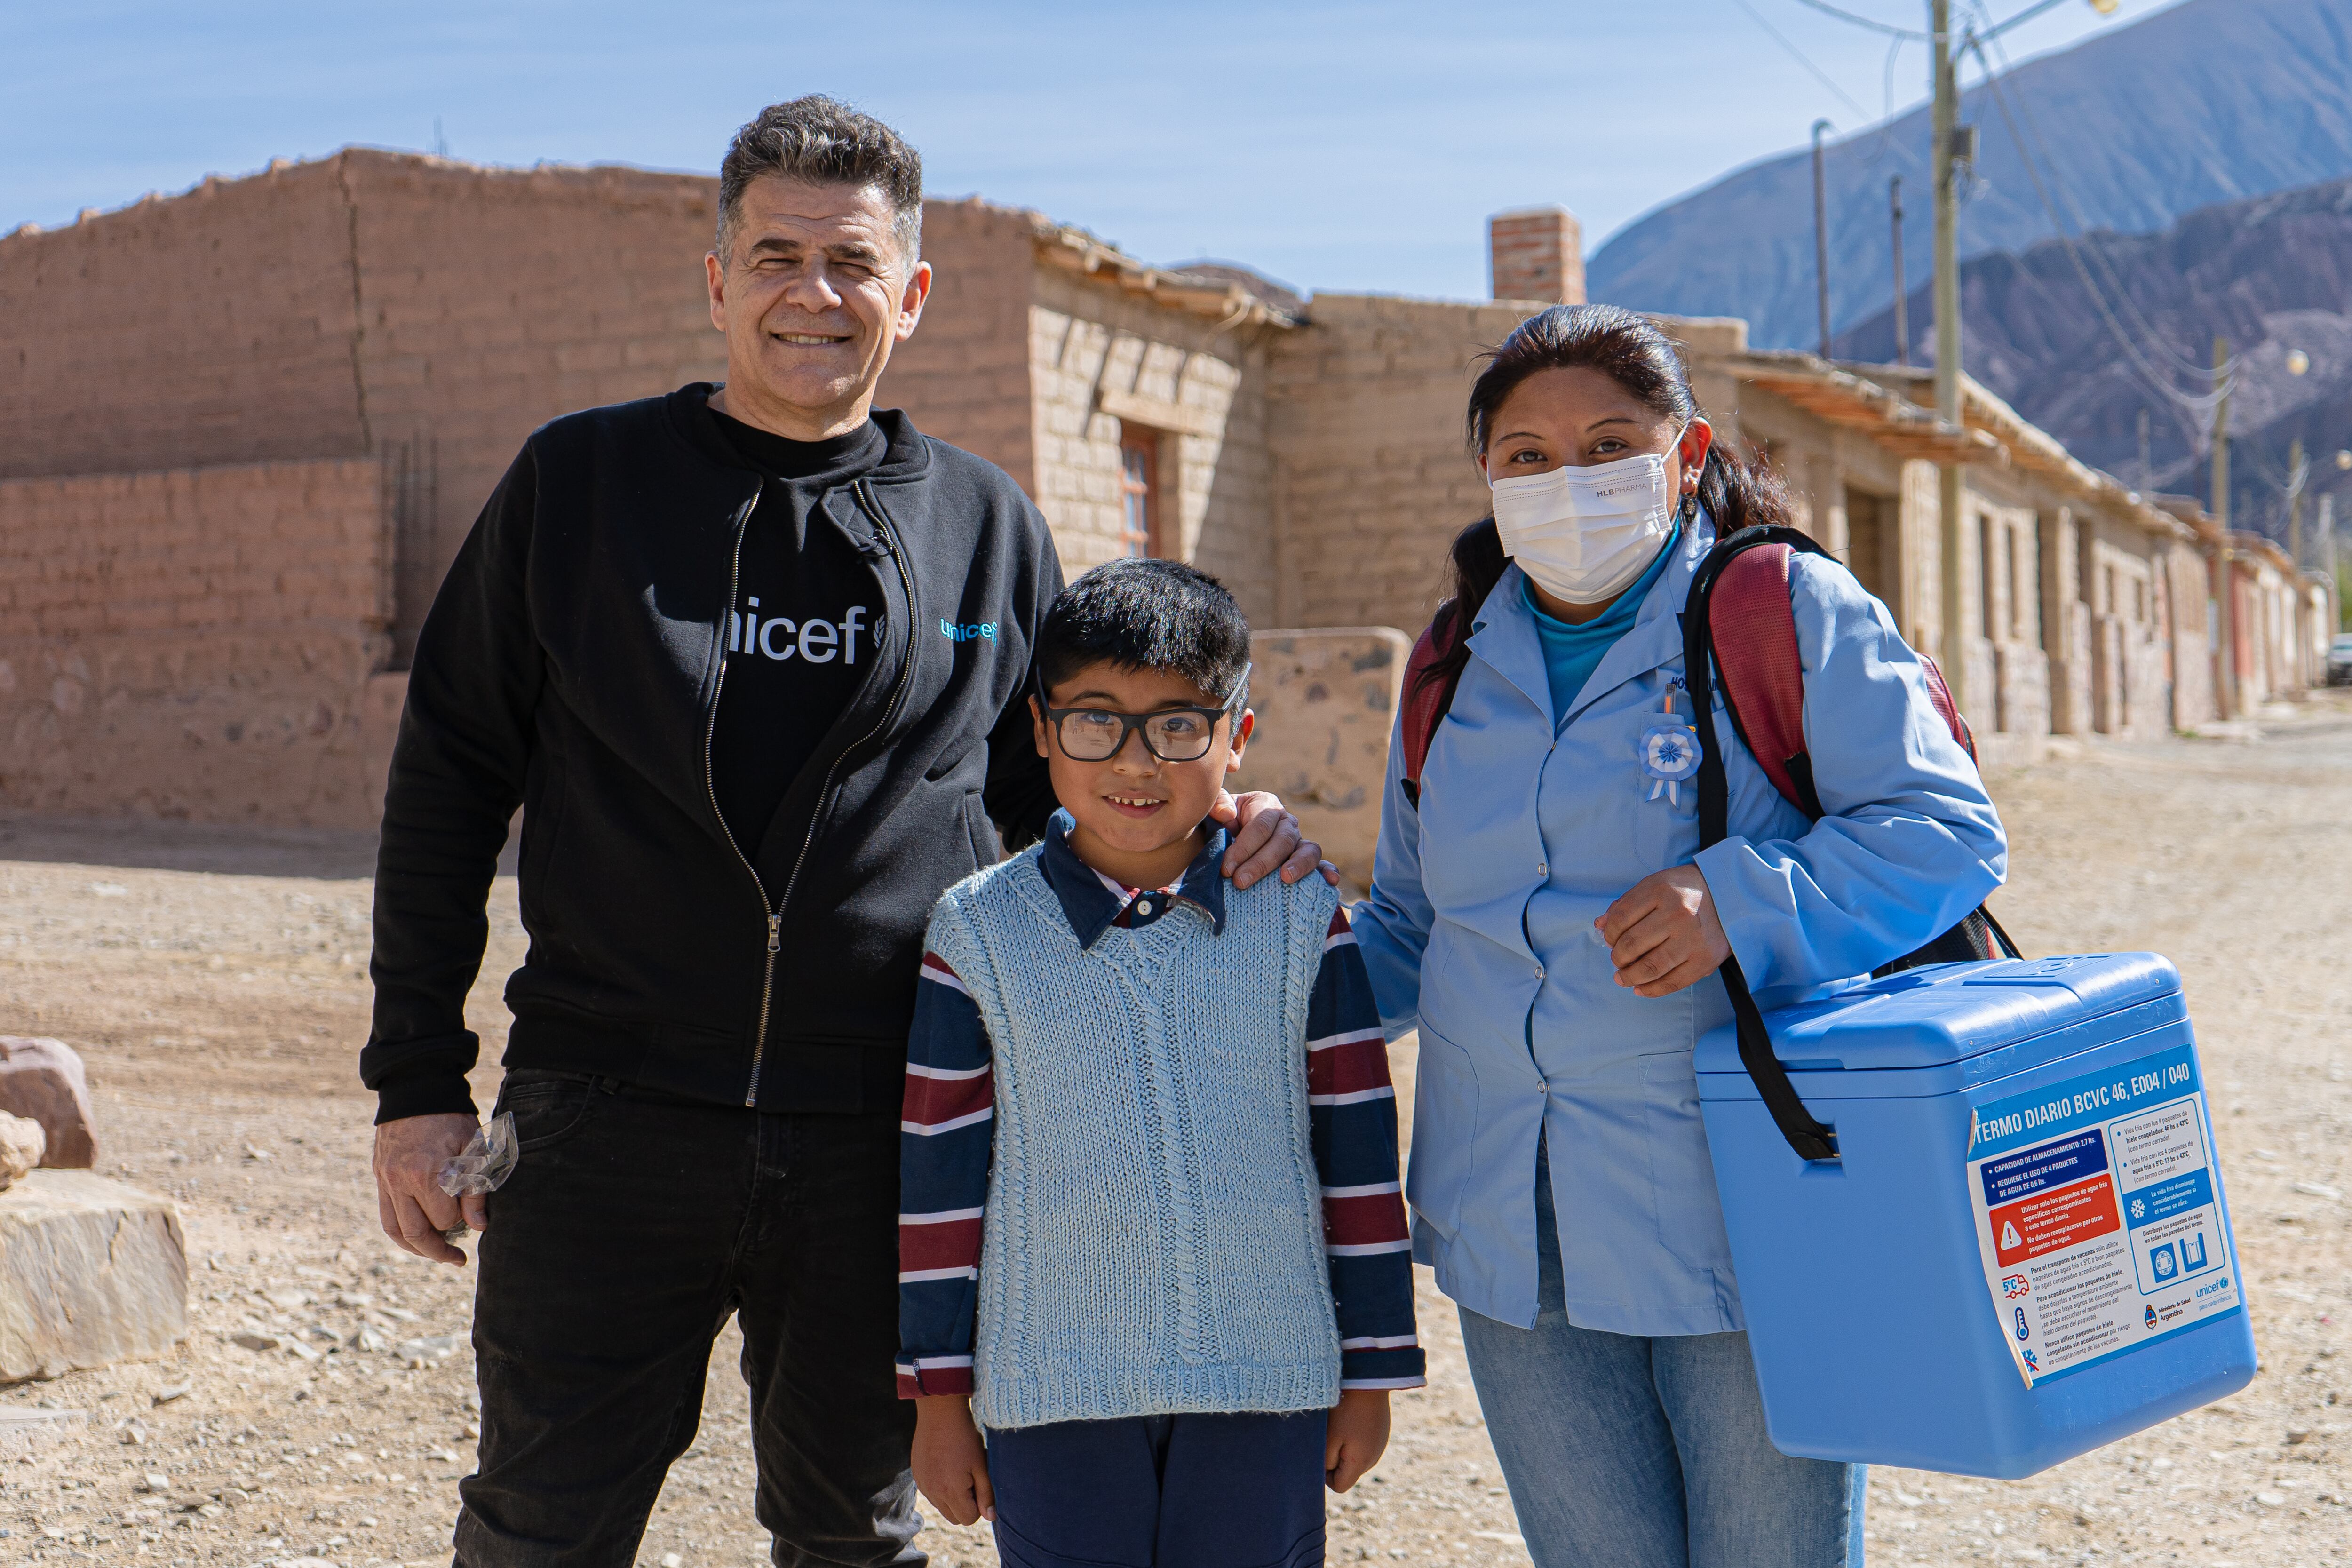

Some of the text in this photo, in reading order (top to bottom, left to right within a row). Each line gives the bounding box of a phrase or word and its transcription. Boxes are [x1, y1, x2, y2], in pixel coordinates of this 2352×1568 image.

[1597, 483, 1648, 497] HLBPHARMA
[941, 618, 997, 643] unicef
[1975, 1113, 2022, 1144] TERMO
[2025, 1098, 2071, 1129] DIARIO
[2073, 1086, 2109, 1114] BCVC
[2130, 1072, 2160, 1096] E004
[2163, 1068, 2166, 1089] /
[2169, 1063, 2189, 1084] 040
[2162, 1113, 2182, 1124] paquetes
[2126, 1135, 2137, 1144] hielo
[2138, 1141, 2151, 1150] termo
[2168, 1143, 2187, 1154] paquetes
[1994, 1158, 2024, 1173] CAPACIDAD
[2024, 1155, 2032, 1164] DE
[1997, 1174, 2023, 1187] REQUIERE
[2029, 1168, 2041, 1178] USO
[2052, 1156, 2078, 1170] PAQUETES
[2008, 1185, 2023, 1195] AGUA
[2022, 1182, 2030, 1190] DE
[2021, 1204, 2038, 1213] Utilizar
[2058, 1191, 2080, 1203] paquetes
[2087, 1185, 2099, 1193] agua
[2051, 1196, 2091, 1213] correspondientes
[2035, 1232, 2050, 1241] deben
[2050, 1222, 2082, 1236] reemplazarse
[2082, 1219, 2090, 1227] por
[2040, 1218, 2054, 1226] termo
[2142, 1226, 2163, 1237] Distribuya
[2169, 1218, 2187, 1229] paquetes
[2169, 1226, 2184, 1237] paredes
[2028, 1242, 2051, 1254] paquetes
[2033, 1272, 2053, 1284] paquetes
[2105, 1248, 2125, 1259] paquetes
[2047, 1257, 2070, 1268] transporte
[2076, 1249, 2095, 1258] vacunas
[2041, 1281, 2052, 1289] agua
[2052, 1273, 2078, 1285] congelados
[2048, 1285, 2076, 1299] acondicionar
[2085, 1276, 2105, 1288] paquetes
[2196, 1279, 2219, 1297] unicef
[2038, 1303, 2050, 1312] debe
[2050, 1297, 2068, 1307] dejarlos
[2072, 1287, 2098, 1300] temperatura
[2099, 1280, 2119, 1290] ambiente
[2073, 1299, 2088, 1308] signos
[2094, 1284, 2133, 1301] descongelamiento
[2158, 1303, 2176, 1313] Ministerio
[2160, 1309, 2183, 1321] Argentina
[2043, 1328, 2054, 1337] hielo
[2055, 1323, 2069, 1332] dentro
[2044, 1339, 2060, 1348] Nunca
[2060, 1334, 2074, 1343] utilice
[2075, 1327, 2096, 1339] paquetes
[2102, 1320, 2114, 1329] hielo
[2047, 1344, 2072, 1357] congelados
[2080, 1331, 2109, 1345] acondicionar
[2117, 1323, 2130, 1332] riesgo
[2055, 1348, 2087, 1363] congelamiento
